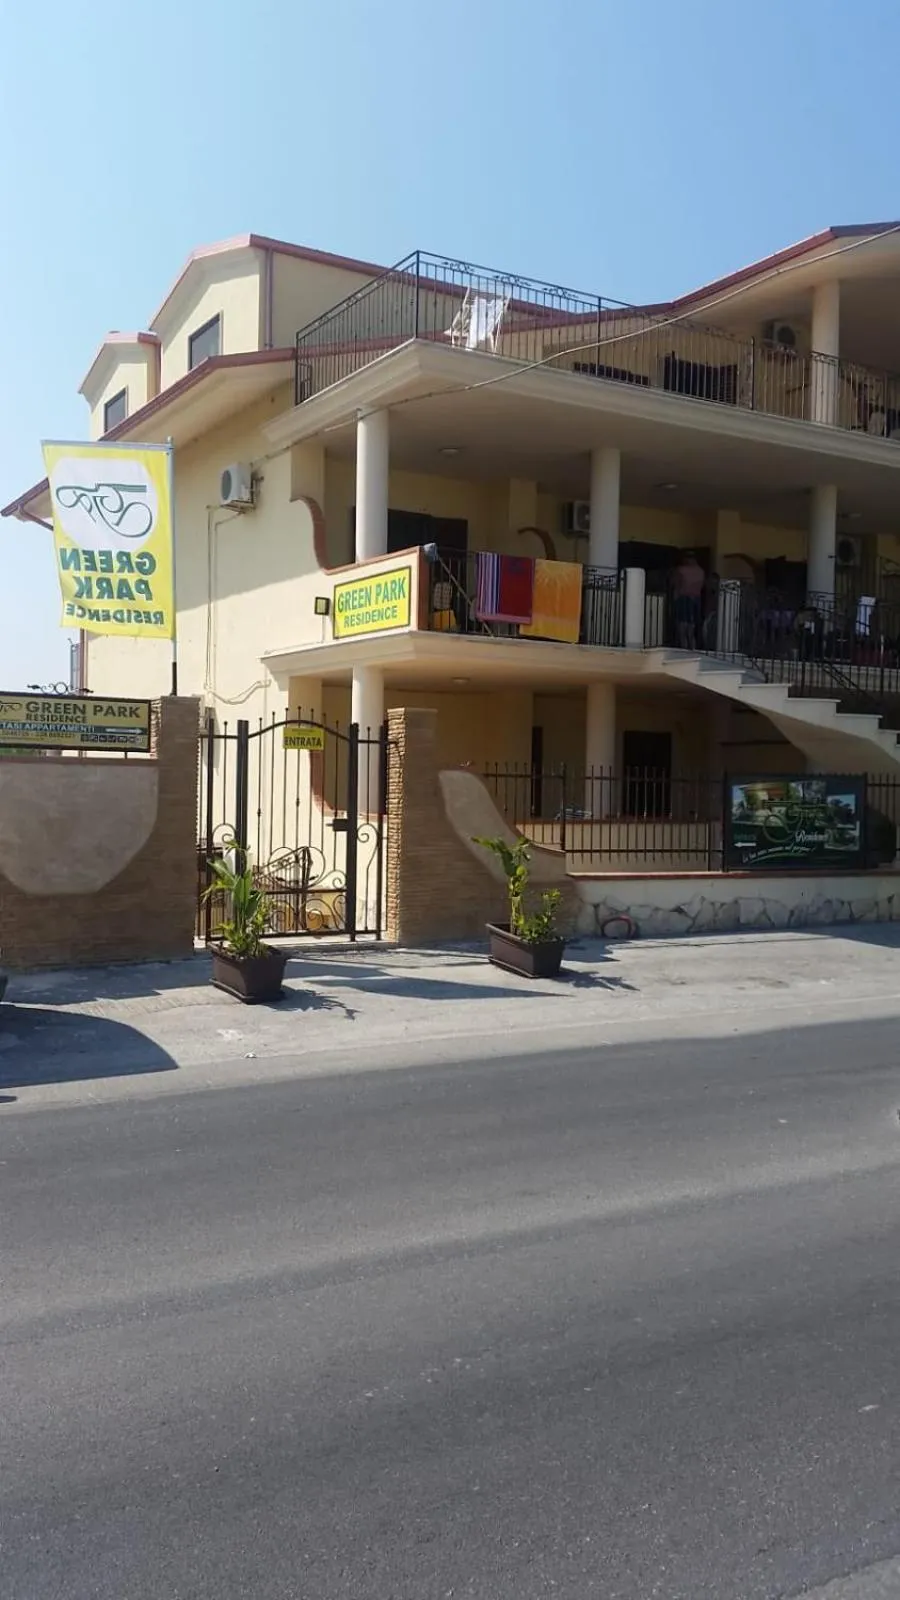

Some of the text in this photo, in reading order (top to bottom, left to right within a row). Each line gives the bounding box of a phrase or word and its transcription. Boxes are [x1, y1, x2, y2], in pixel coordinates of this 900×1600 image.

[337, 577, 406, 613] GREEN PARK
[343, 605, 398, 628] RESIDENCE
[26, 701, 140, 718] GREEN PARK
[25, 713, 88, 724] RESIDENCE
[284, 736, 322, 747] ENTRATA
